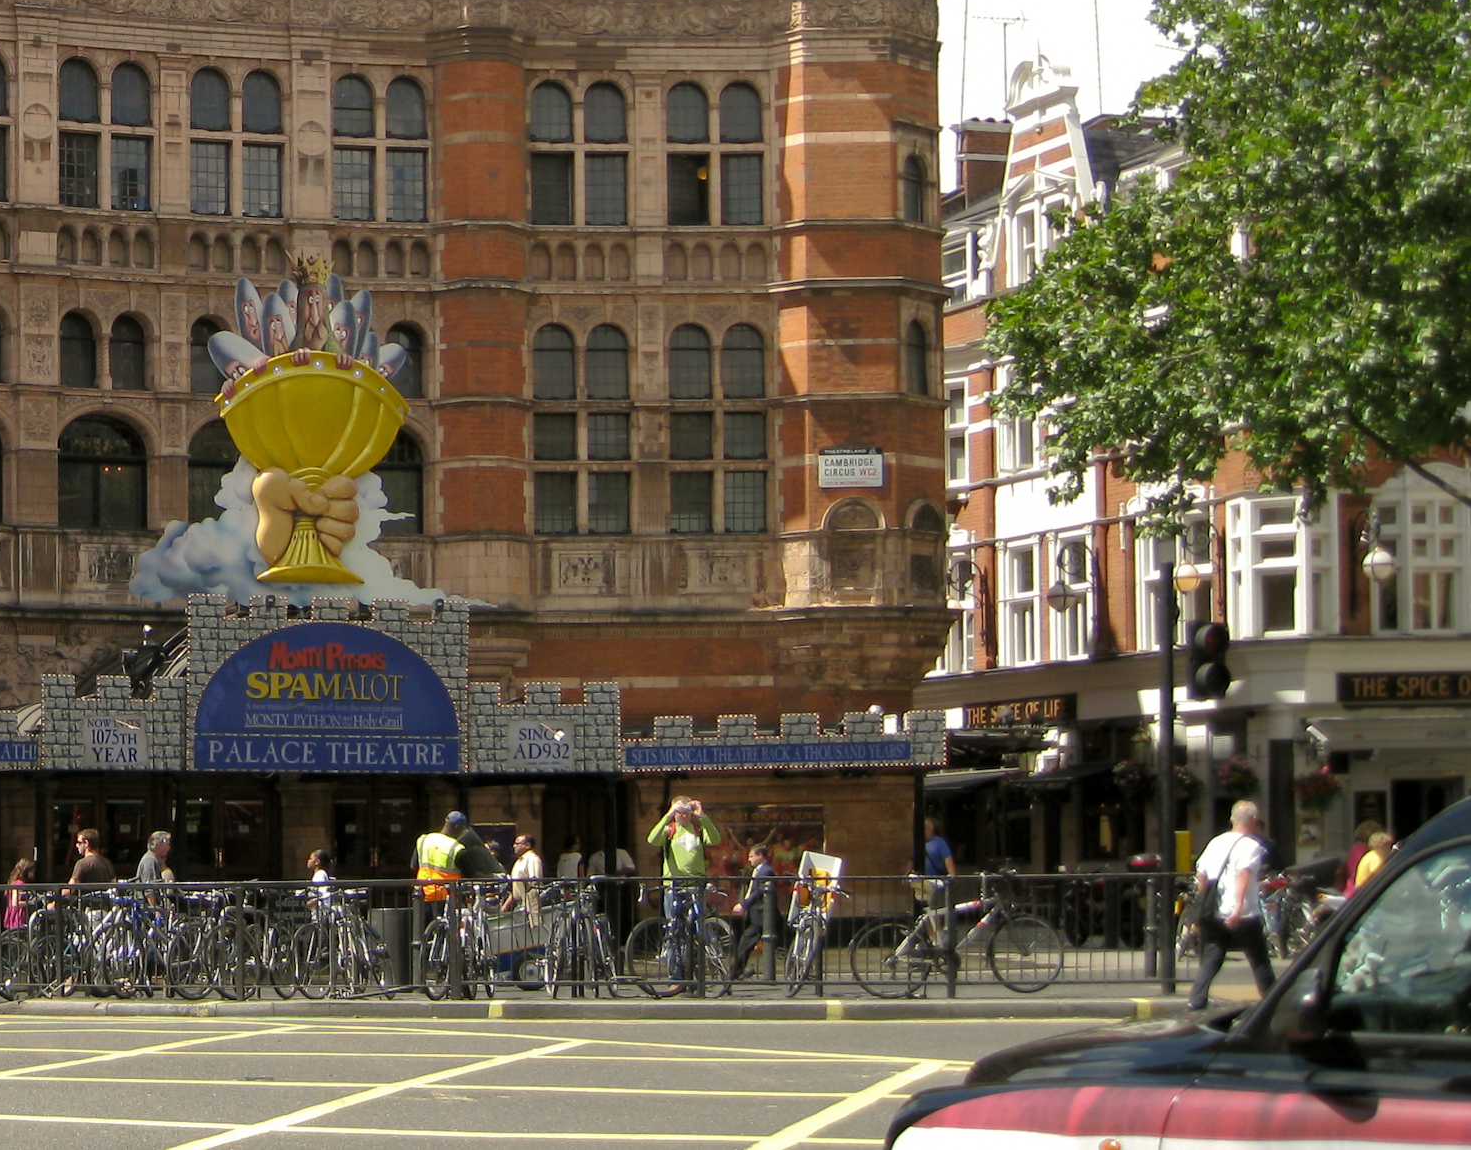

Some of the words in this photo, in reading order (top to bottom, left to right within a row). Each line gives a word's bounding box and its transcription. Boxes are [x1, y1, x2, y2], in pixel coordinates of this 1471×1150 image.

[824, 458, 875, 467] CAMBRIDGE
[824, 468, 856, 477] CIRCUS
[859, 467, 878, 476] WC2
[245, 671, 404, 702] SPAMALOT
[1352, 677, 1388, 698] THE
[1396, 676, 1449, 697] SPICE
[1458, 675, 1471, 696] O
[87, 719, 111, 728] NOW
[245, 713, 289, 726] MONTY
[294, 714, 341, 727] PYTHON
[353, 713, 378, 729] Holy
[379, 714, 403, 728] Grail
[966, 707, 987, 725] THE
[92, 729, 137, 745] 1075TH
[518, 728, 565, 741] SINC
[91, 747, 138, 763] YEAR
[208, 740, 317, 764] PALACE
[325, 742, 446, 765] THEATRE
[513, 743, 569, 759] AD932
[631, 749, 657, 764] SETS
[660, 748, 709, 763] MUSICAL
[712, 746, 758, 762] THEATRE
[762, 745, 791, 761] BACK
[793, 748, 801, 760] A
[803, 744, 866, 760] THOUSAND
